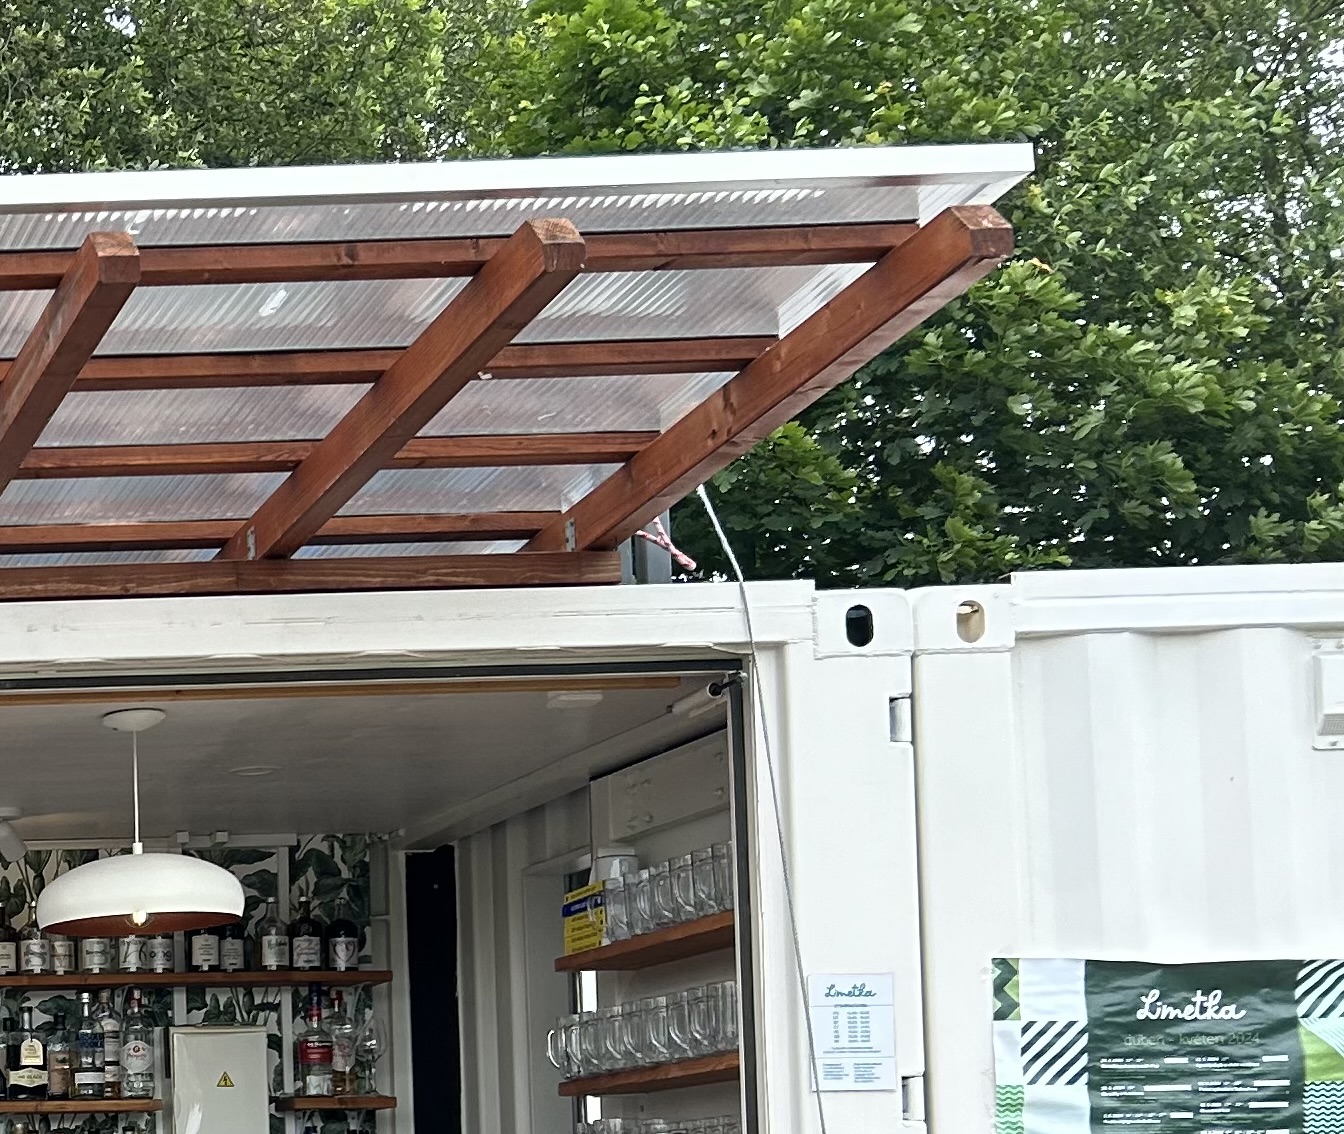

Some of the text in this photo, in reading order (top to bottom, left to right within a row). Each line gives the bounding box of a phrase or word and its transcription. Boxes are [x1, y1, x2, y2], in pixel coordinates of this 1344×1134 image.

[824, 983, 877, 998] Limetka
[1137, 989, 1247, 1021] Limetka
[1227, 1032, 1261, 1045] 2024
